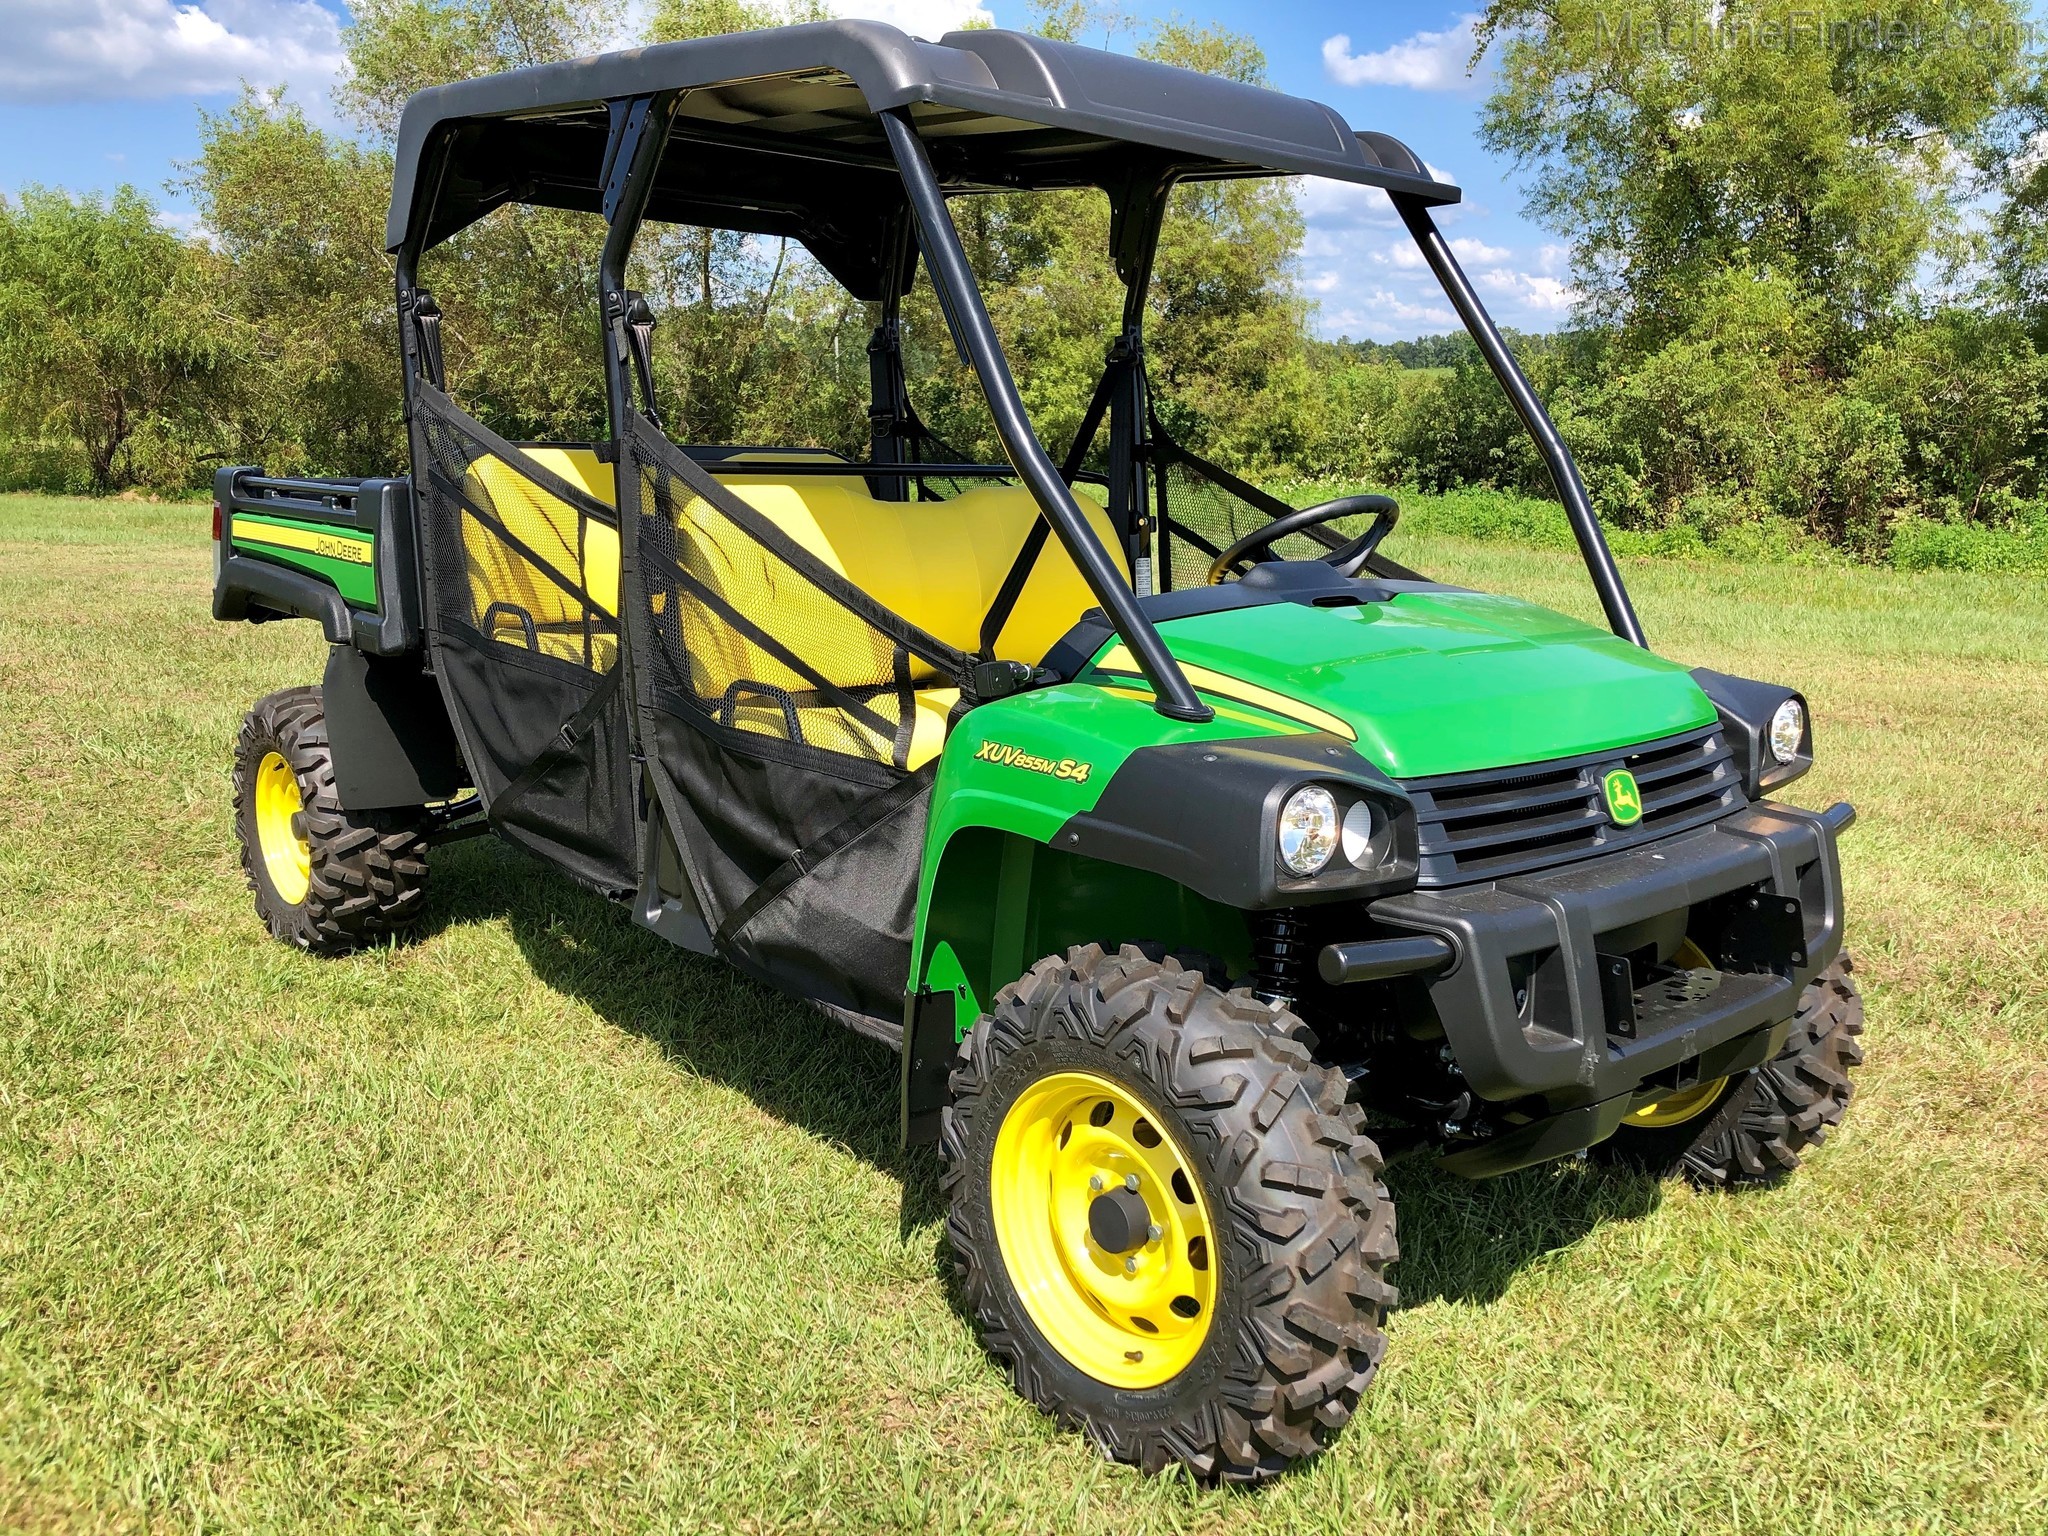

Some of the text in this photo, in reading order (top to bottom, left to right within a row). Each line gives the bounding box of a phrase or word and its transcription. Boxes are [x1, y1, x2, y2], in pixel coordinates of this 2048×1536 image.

[315, 537, 362, 560] JOHN DEERE
[1055, 758, 1091, 783] S4
